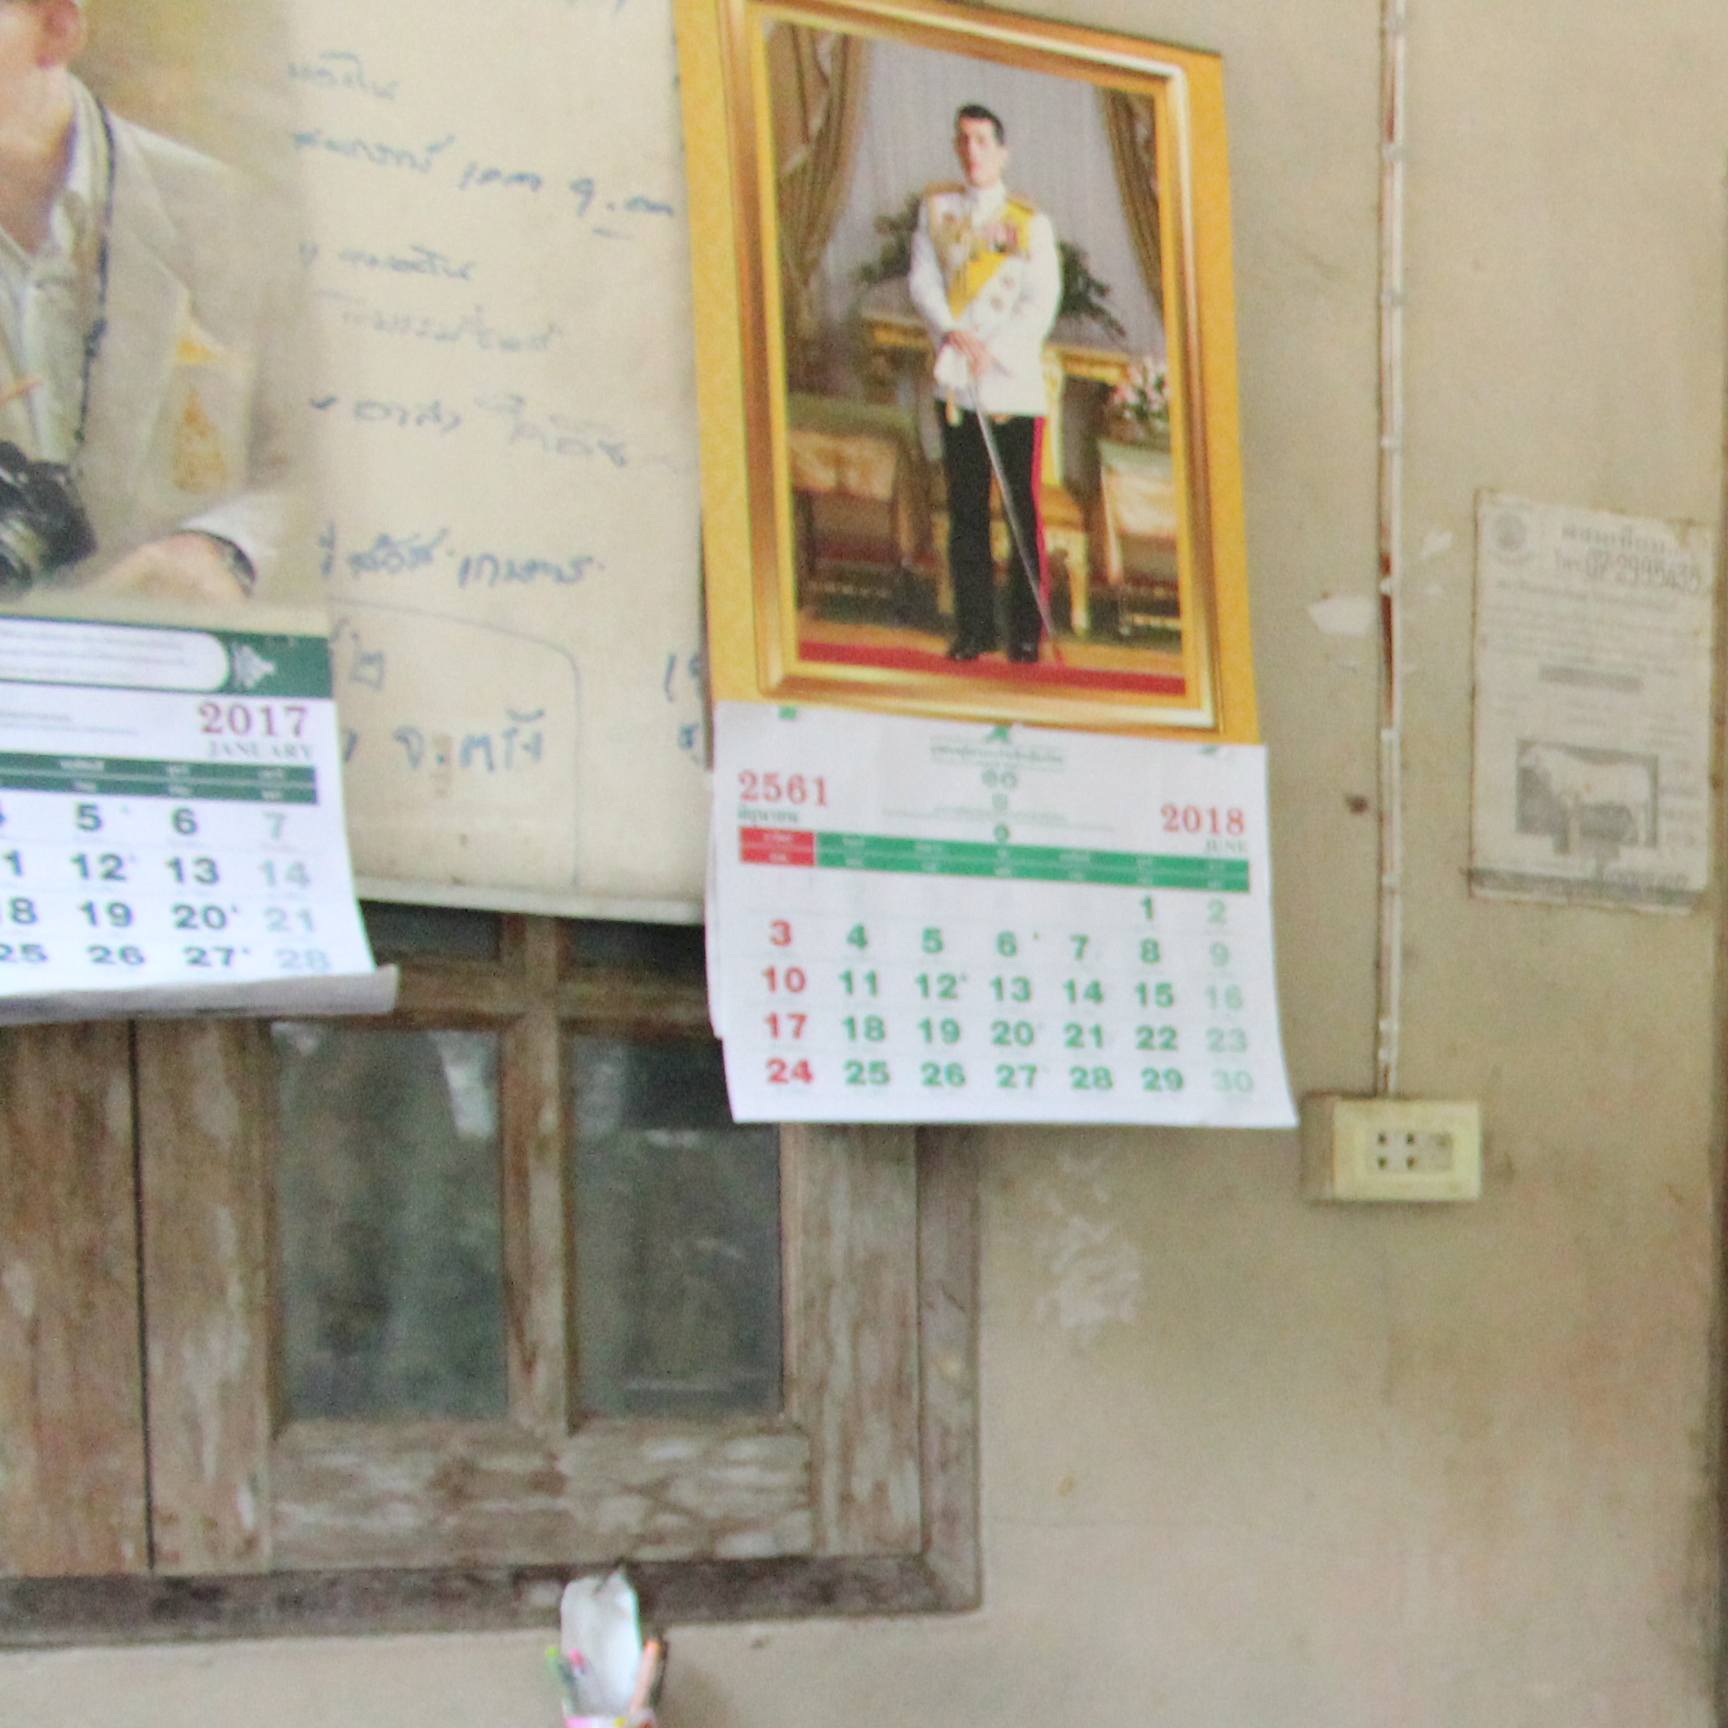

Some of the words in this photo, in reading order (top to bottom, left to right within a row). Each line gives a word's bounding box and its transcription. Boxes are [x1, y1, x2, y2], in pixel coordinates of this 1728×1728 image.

[197, 700, 309, 738] 2017
[738, 770, 828, 808] 2561
[74, 802, 104, 832] 5
[170, 806, 199, 836] 6
[1160, 804, 1246, 836] 2018
[3, 848, 23, 877] 1
[71, 852, 126, 882] 12
[166, 855, 221, 886] 13
[8, 896, 38, 925] 8
[80, 900, 135, 929] 19
[172, 902, 228, 930] 20
[1140, 894, 1155, 920] 1
[0, 942, 49, 962] 25
[87, 945, 146, 965] 26
[183, 945, 235, 967] 27
[771, 918, 793, 947] 3
[846, 924, 869, 950] 4
[922, 927, 944, 954] 5
[995, 931, 1018, 958] 6
[1071, 934, 1090, 960] 7
[1139, 938, 1162, 966] 8
[763, 966, 808, 995] 10
[839, 968, 879, 996] 11
[916, 972, 958, 1000] 12
[990, 976, 1034, 1003] 13
[1064, 979, 1105, 1004] 14
[1136, 981, 1176, 1008] 15
[765, 1012, 807, 1039] 17
[843, 1013, 887, 1042] 18
[918, 1017, 961, 1044] 19
[992, 1019, 1035, 1046] 20
[1064, 1021, 1104, 1049] 21
[1136, 1024, 1178, 1051] 22
[767, 1057, 814, 1084] 24
[845, 1059, 891, 1085] 25
[921, 1061, 967, 1087] 26
[996, 1063, 1039, 1089] 27
[1070, 1065, 1115, 1090] 28
[1141, 1067, 1186, 1092] 29
